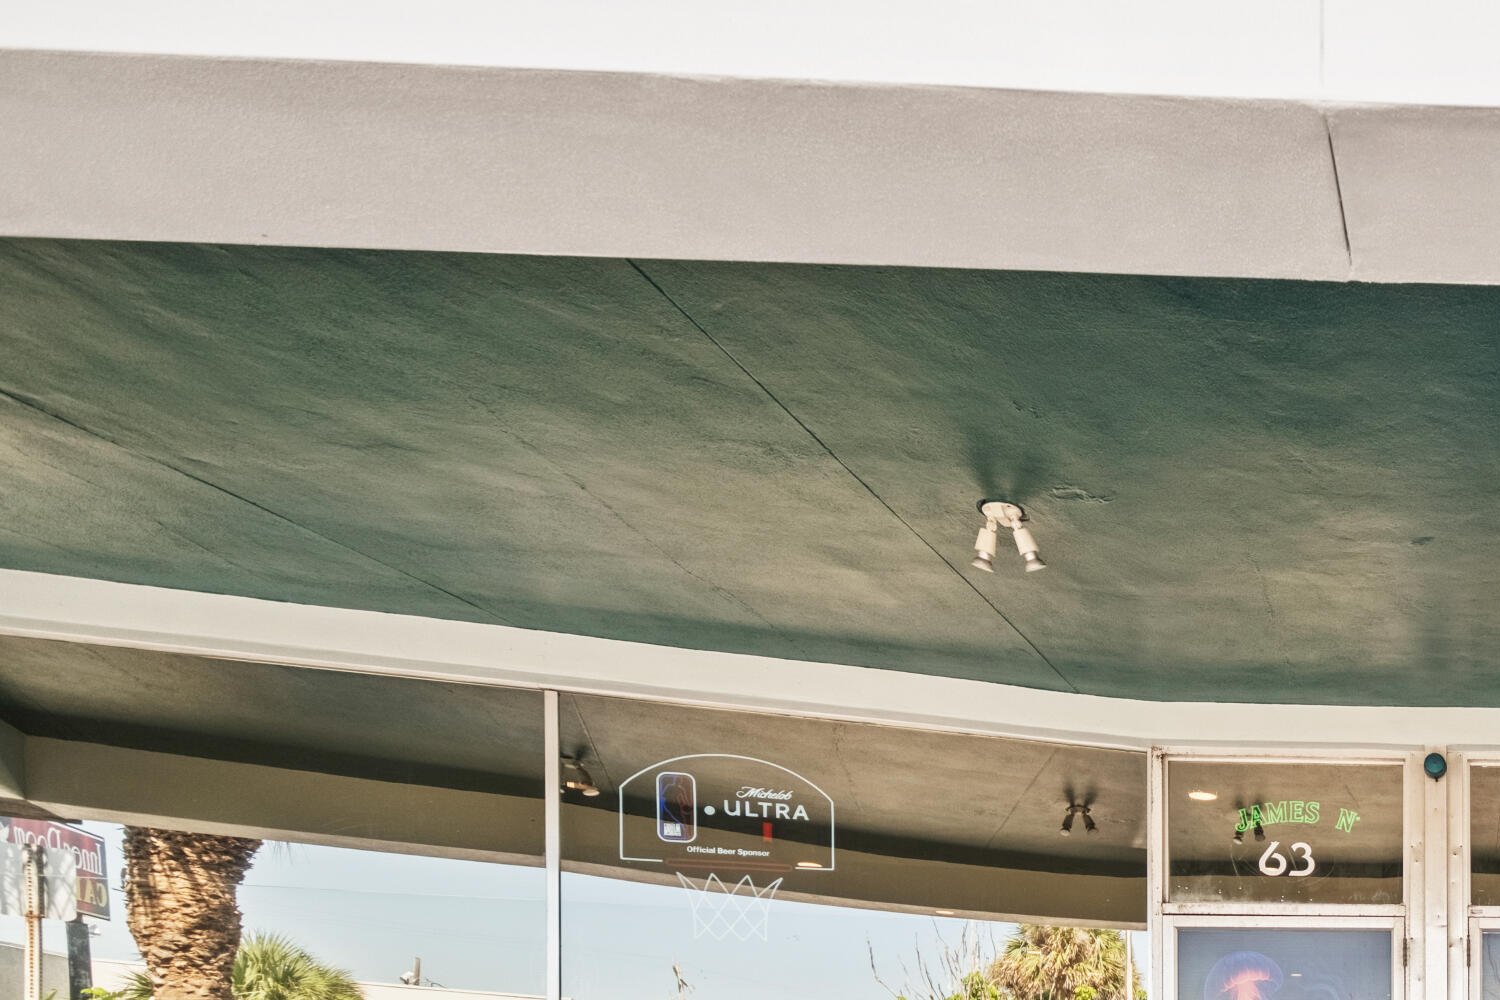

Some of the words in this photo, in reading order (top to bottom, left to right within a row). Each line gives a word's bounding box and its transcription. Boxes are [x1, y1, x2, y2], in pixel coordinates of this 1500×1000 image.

[736, 787, 793, 800] Michelob
[724, 800, 809, 821] ULTRA
[687, 846, 716, 855] Official
[717, 848, 736, 856] Beer
[737, 849, 770, 857] Sponsor
[1258, 840, 1315, 877] 63
